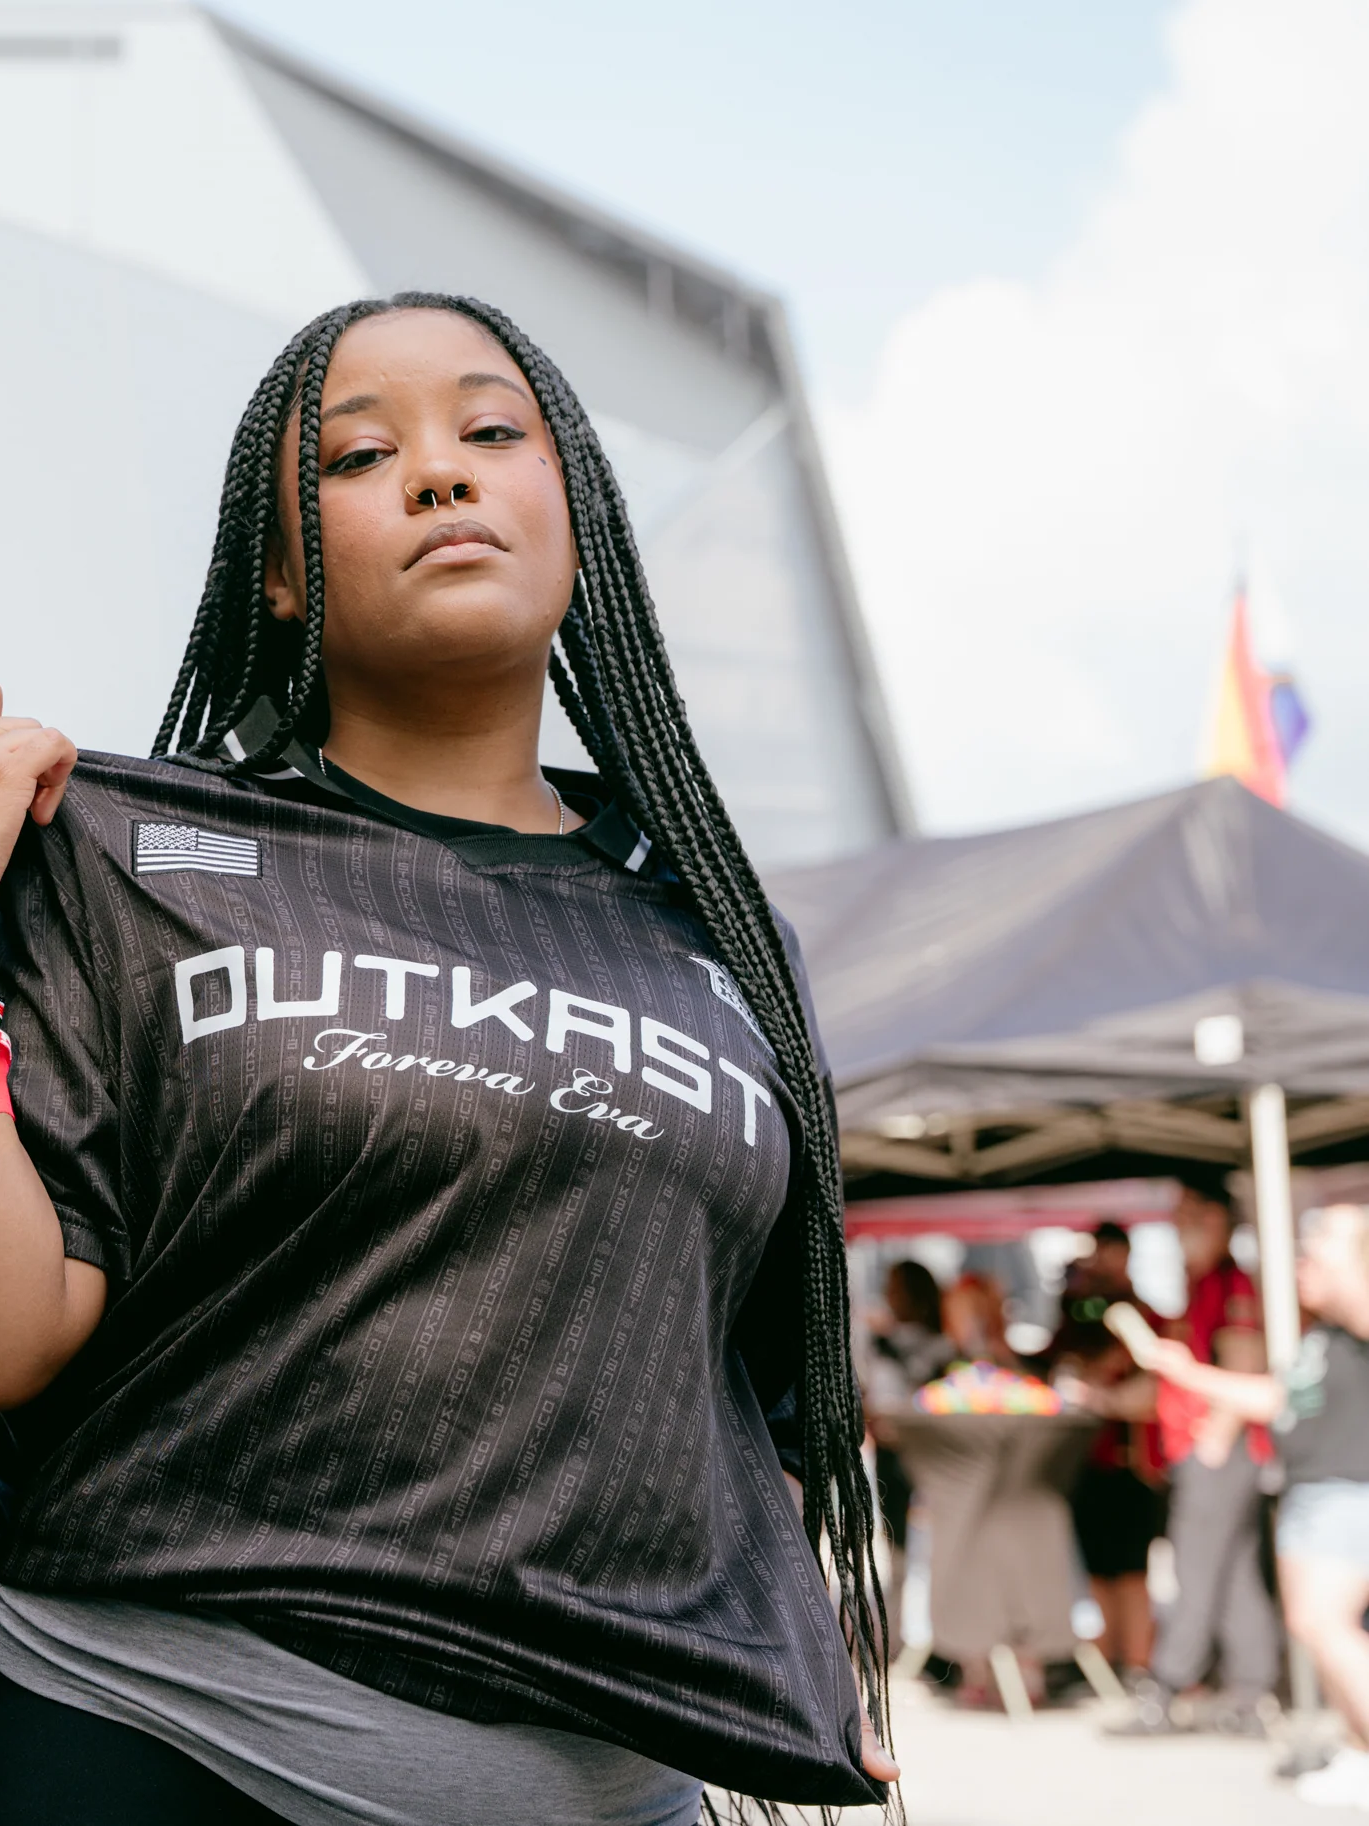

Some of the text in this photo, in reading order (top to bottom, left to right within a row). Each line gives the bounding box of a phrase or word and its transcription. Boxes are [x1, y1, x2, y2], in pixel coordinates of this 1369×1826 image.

[175, 945, 771, 1147] OUTKAST
[303, 1028, 665, 1142] Foreva Eva
[523, 1115, 560, 1204] OUTKAST
[608, 1147, 644, 1236] OUTKAST
[547, 1186, 584, 1274] OUTKAST
[630, 1219, 662, 1309] OUTKAST
[404, 1269, 457, 1388] STANKONIA
[469, 1228, 521, 1345] STANKONIA
[555, 1259, 605, 1377] STANKONIA
[342, 1338, 383, 1422] OUTKAST
[492, 1298, 544, 1418] STANKONIA
[577, 1331, 628, 1452] STANKONIA
[635, 1295, 676, 1414] STANKONIA
[451, 1441, 490, 1529] OUTKAST
[515, 1400, 556, 1489] OUTKAST
[595, 1438, 634, 1525] OUTKAST
[794, 1561, 829, 1633] OUTKAST
